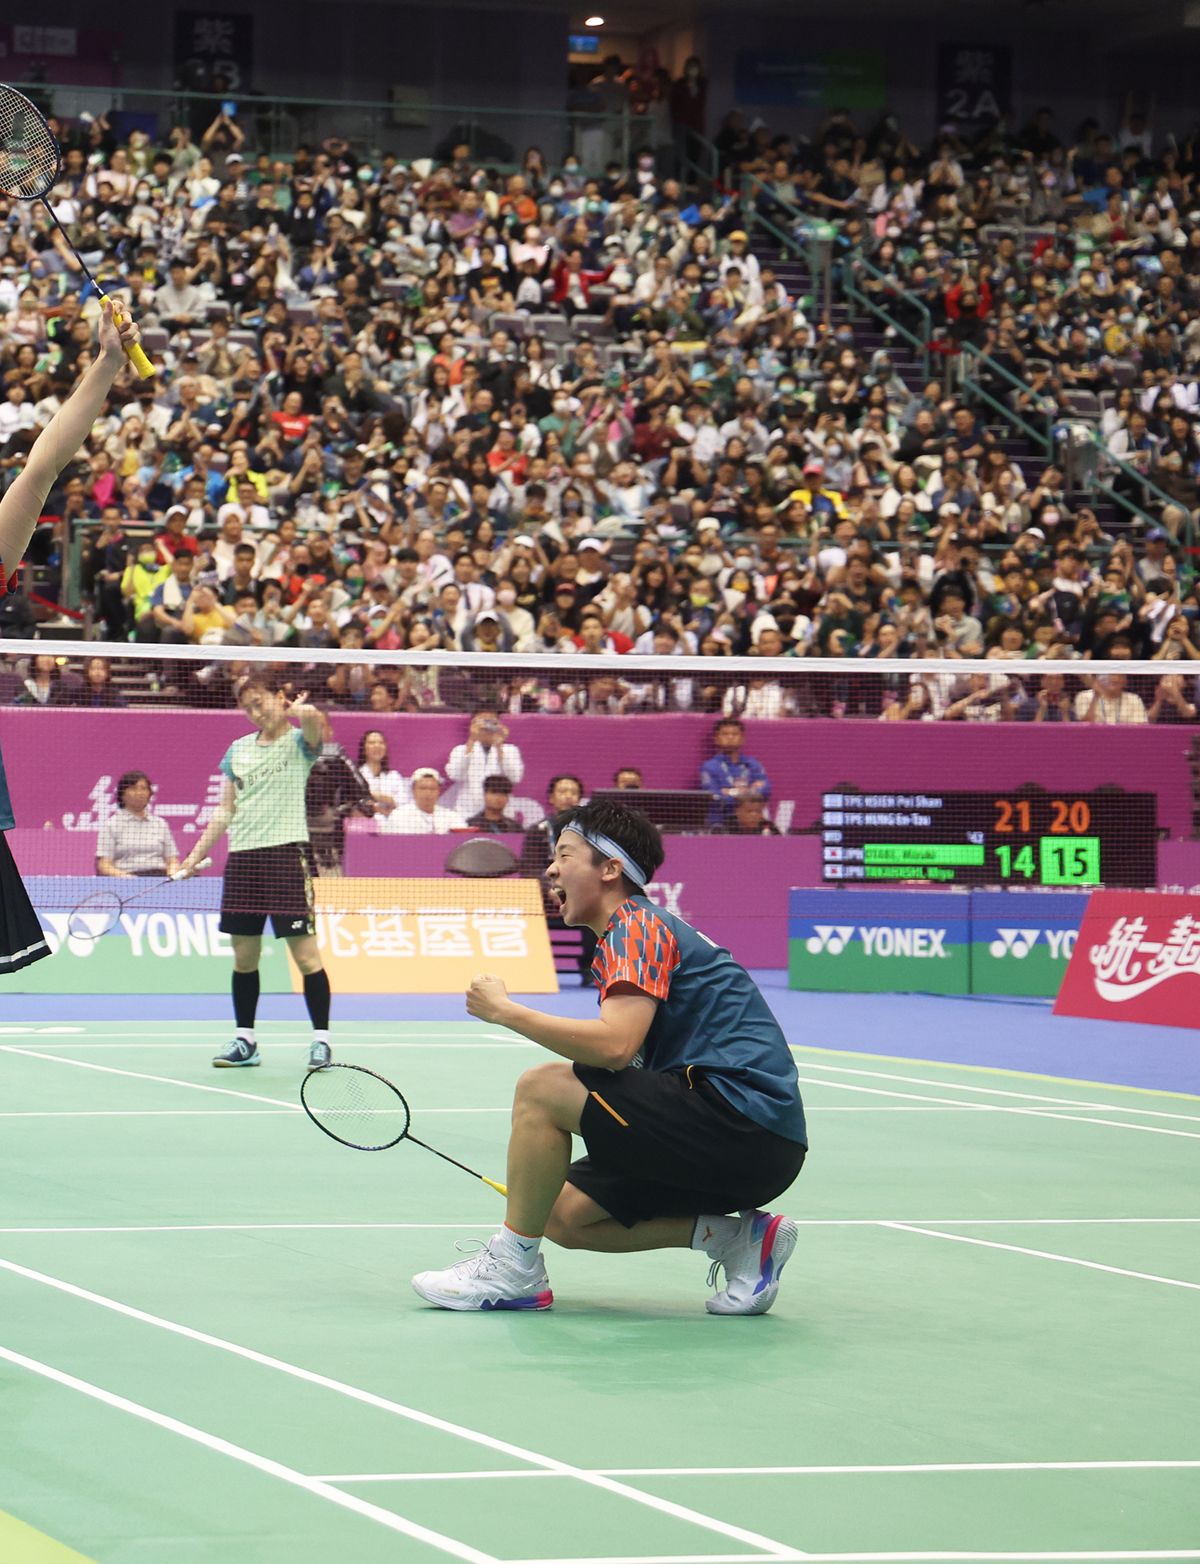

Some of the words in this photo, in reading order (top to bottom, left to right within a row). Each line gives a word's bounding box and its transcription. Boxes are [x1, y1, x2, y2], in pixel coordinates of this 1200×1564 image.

[945, 88, 1000, 118] 2A
[994, 800, 1031, 832] 21
[1050, 800, 1091, 833] 20
[994, 844, 1036, 878] 14
[1052, 847, 1089, 877] 15
[119, 912, 237, 958] YONE
[858, 926, 947, 959] YONEX
